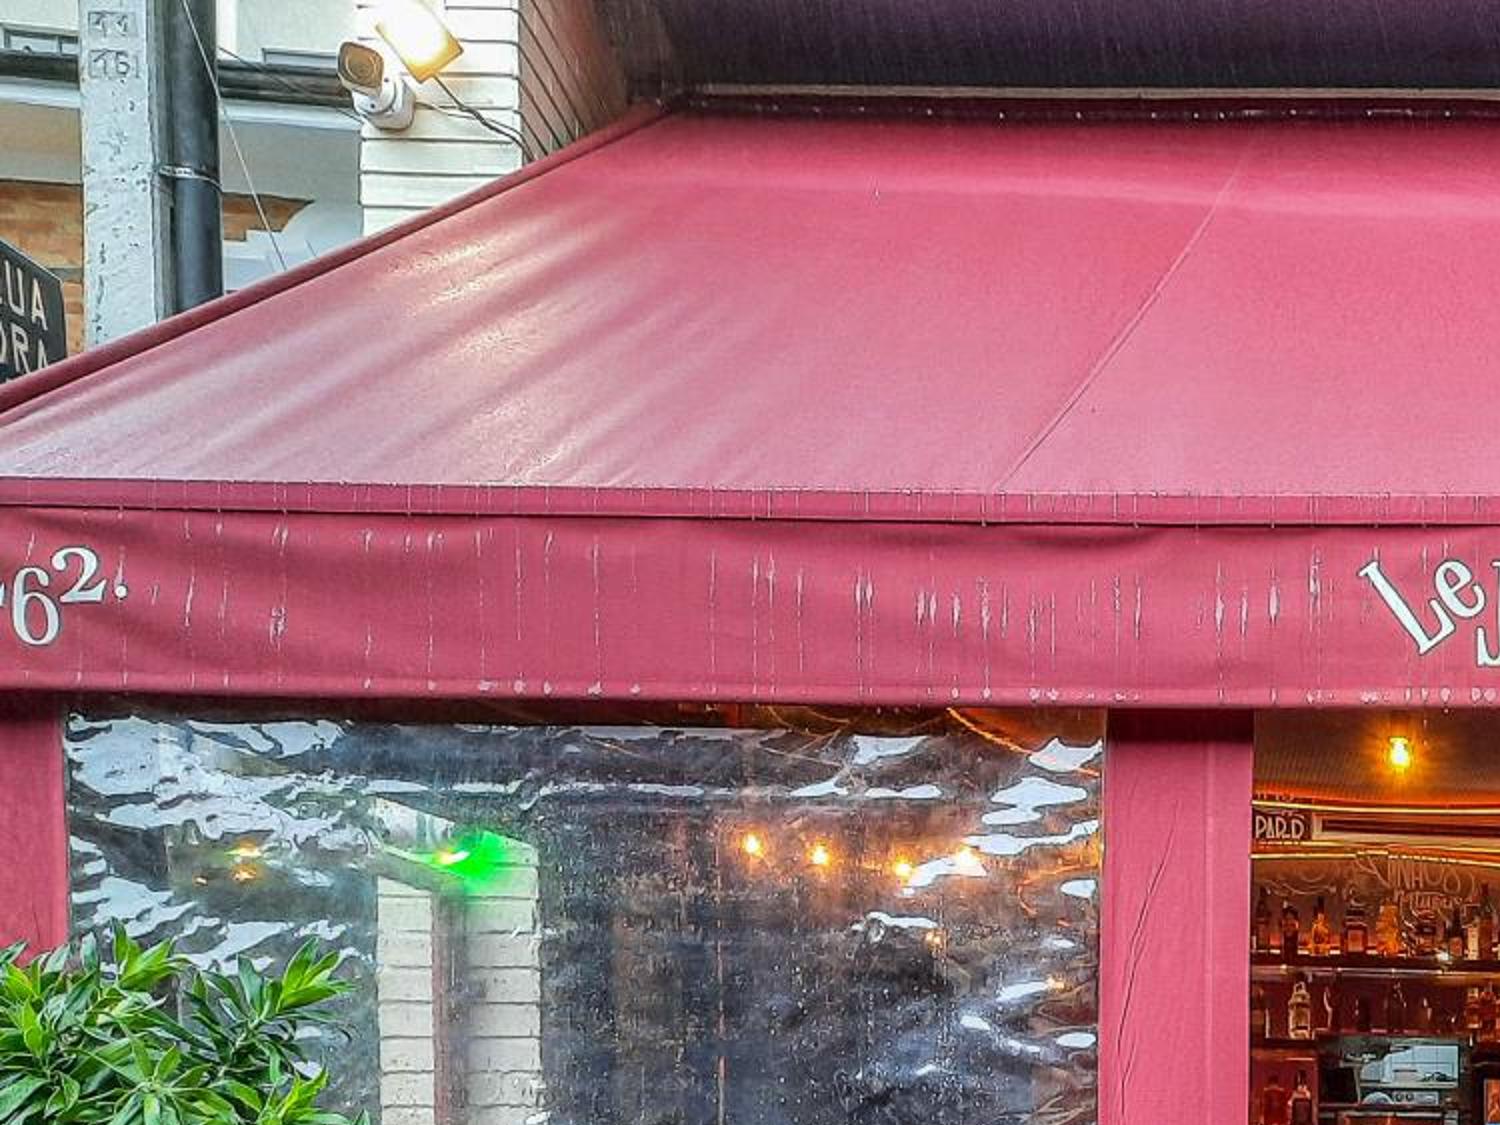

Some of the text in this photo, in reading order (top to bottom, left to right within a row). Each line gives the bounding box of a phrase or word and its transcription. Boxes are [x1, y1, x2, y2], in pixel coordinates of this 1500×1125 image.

[0, 260, 48, 331] UA
[0, 546, 128, 646] 62.
[1357, 557, 1487, 655] Le
